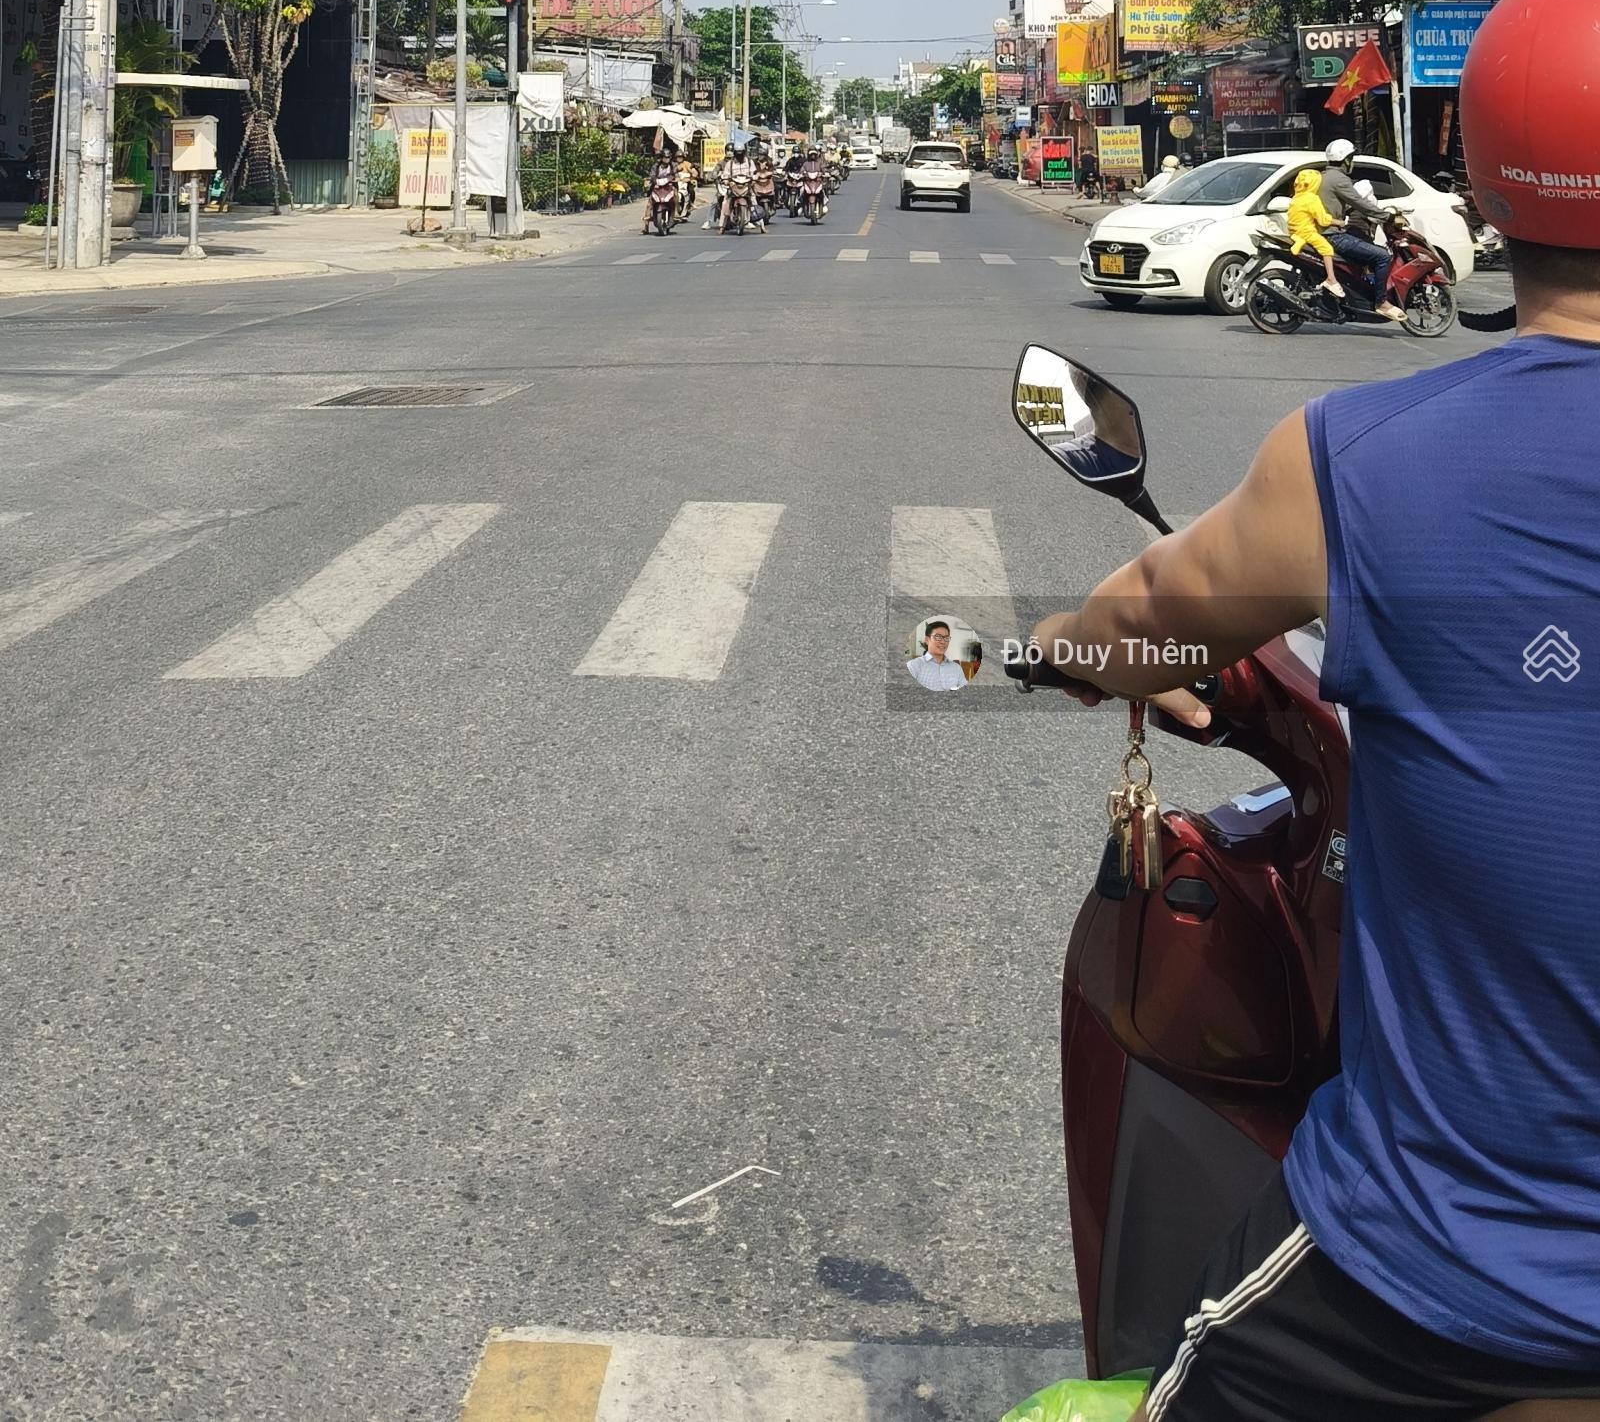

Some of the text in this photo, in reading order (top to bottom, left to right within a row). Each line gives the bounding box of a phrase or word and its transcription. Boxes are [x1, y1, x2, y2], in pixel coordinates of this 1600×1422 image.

[1028, 24, 1045, 32] KHO
[1130, 23, 1150, 34] Phở
[1415, 26, 1475, 46] CHÙA TRÚ
[1305, 29, 1381, 50] COFFEE
[1088, 84, 1118, 106] BIDA
[1500, 164, 1539, 185] HOA
[1540, 172, 1592, 188] BINH
